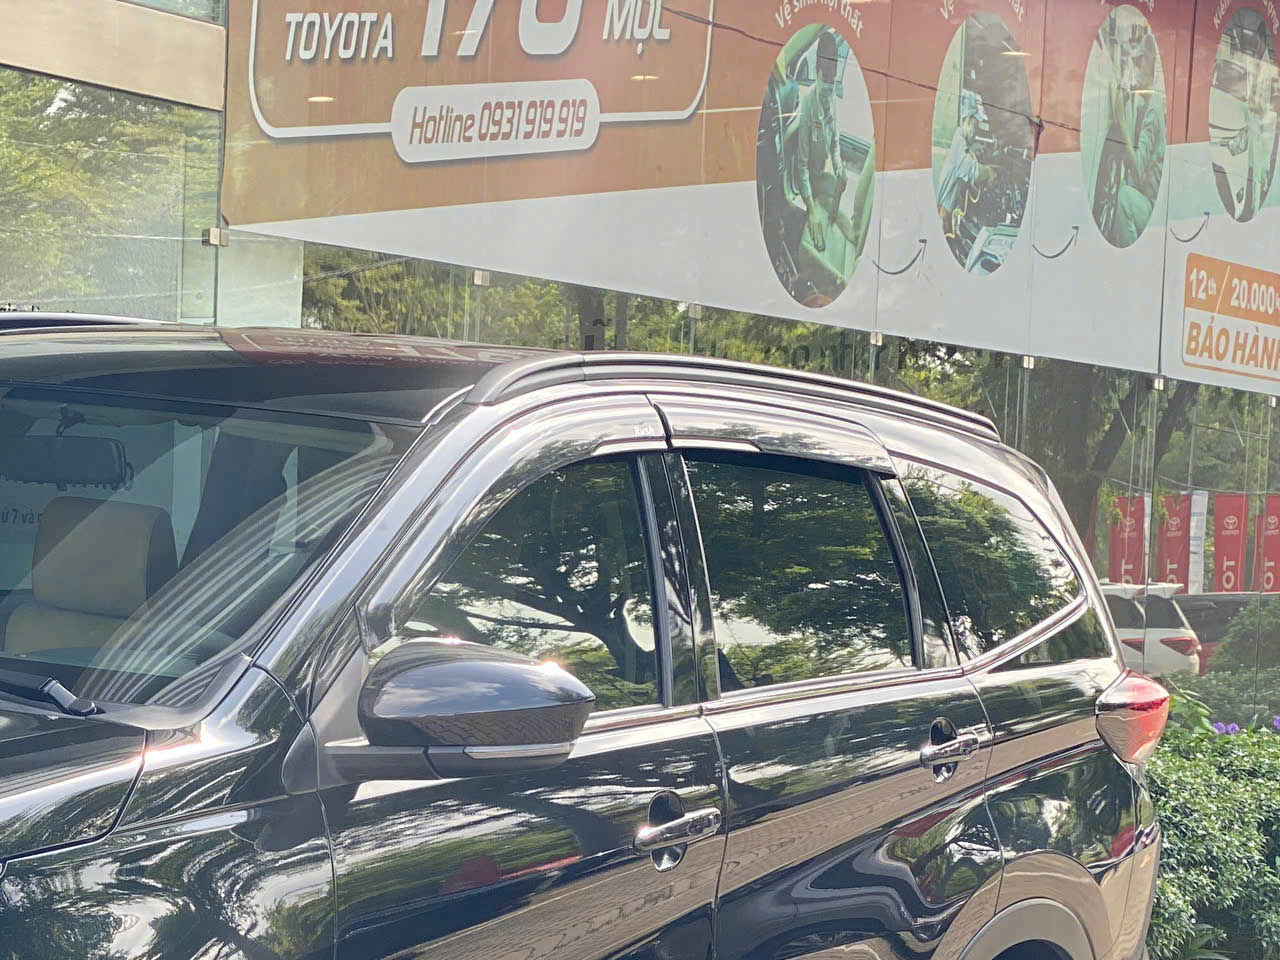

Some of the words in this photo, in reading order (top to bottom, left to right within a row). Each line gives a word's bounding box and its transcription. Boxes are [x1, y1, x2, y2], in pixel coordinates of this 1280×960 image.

[285, 12, 394, 61] TOYOTA
[409, 104, 475, 145] Hotline
[478, 99, 523, 142] 0931
[523, 98, 556, 140] 919
[556, 97, 588, 138] 919
[1185, 314, 1230, 362] BẢO
